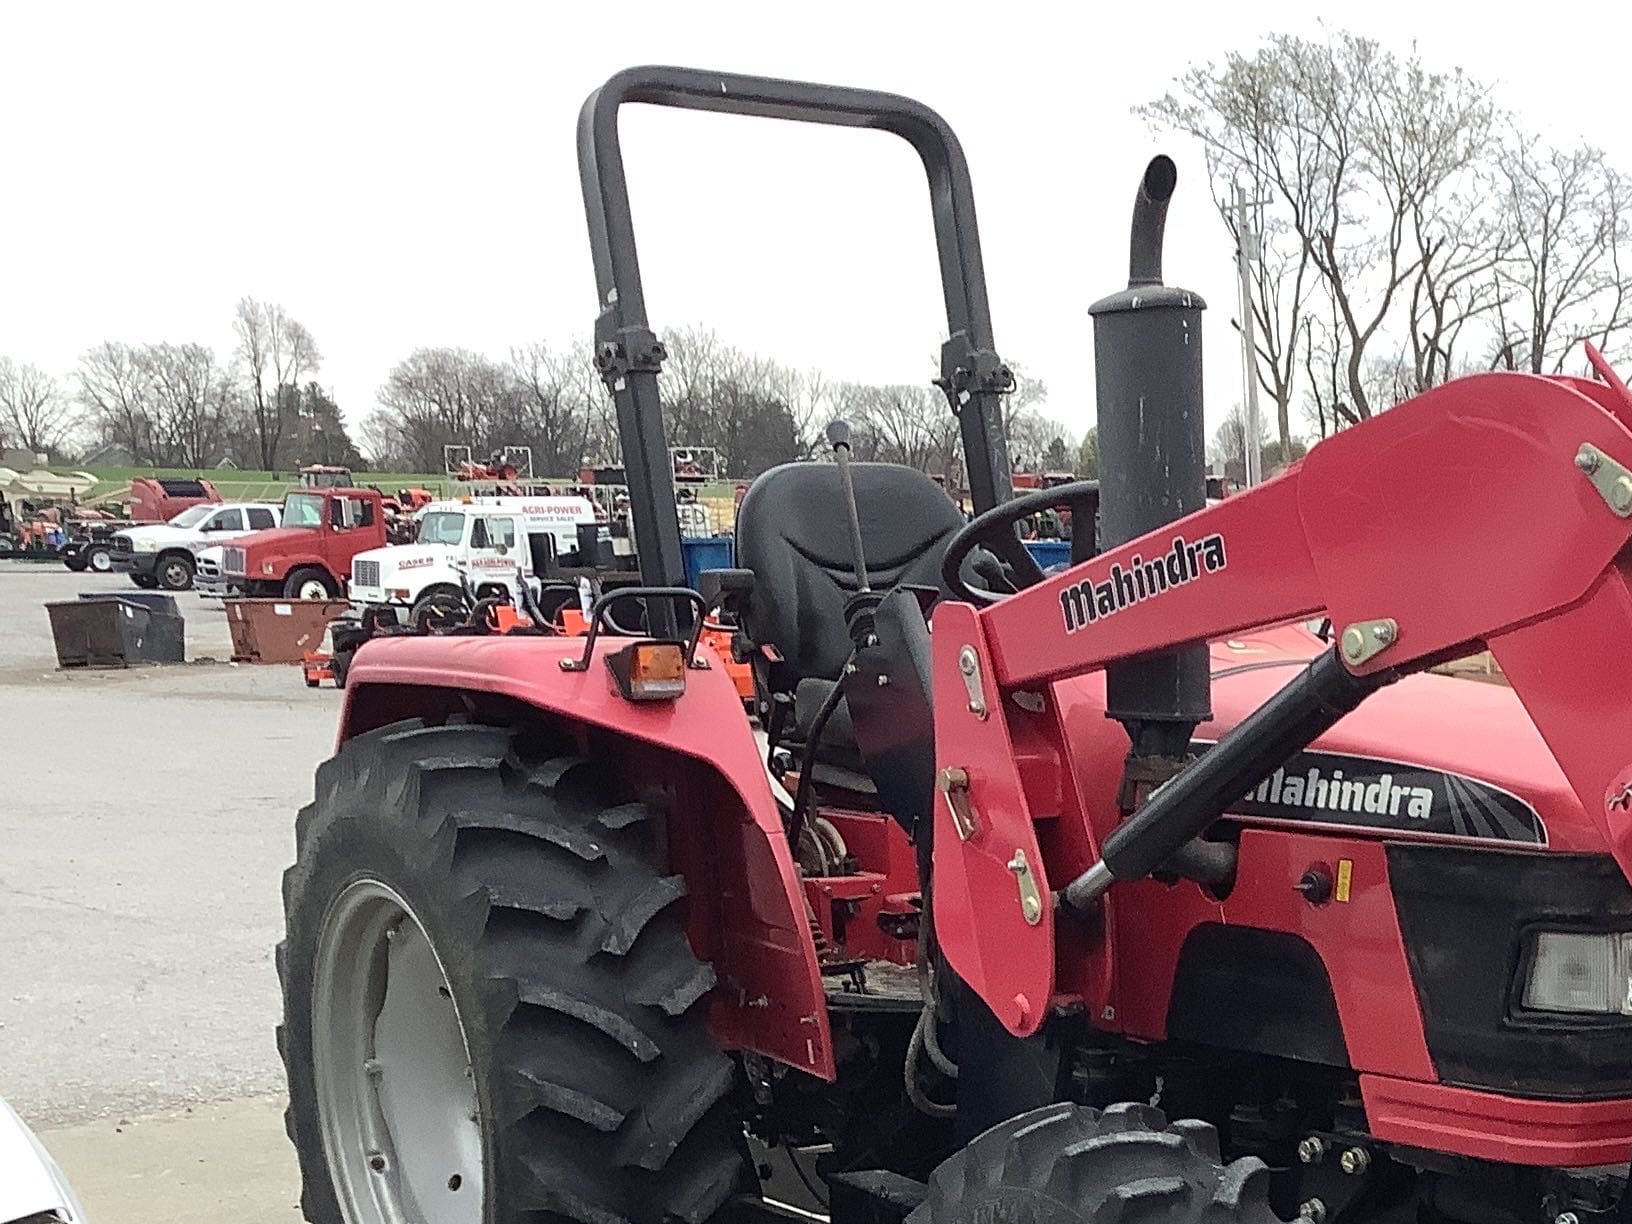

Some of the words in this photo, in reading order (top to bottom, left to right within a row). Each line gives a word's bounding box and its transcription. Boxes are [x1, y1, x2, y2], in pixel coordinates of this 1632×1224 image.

[522, 506, 582, 515] AGRI-POWER
[398, 559, 424, 568] CASE
[1060, 534, 1227, 635] Mahindra
[1244, 766, 1433, 819] Mahindra
